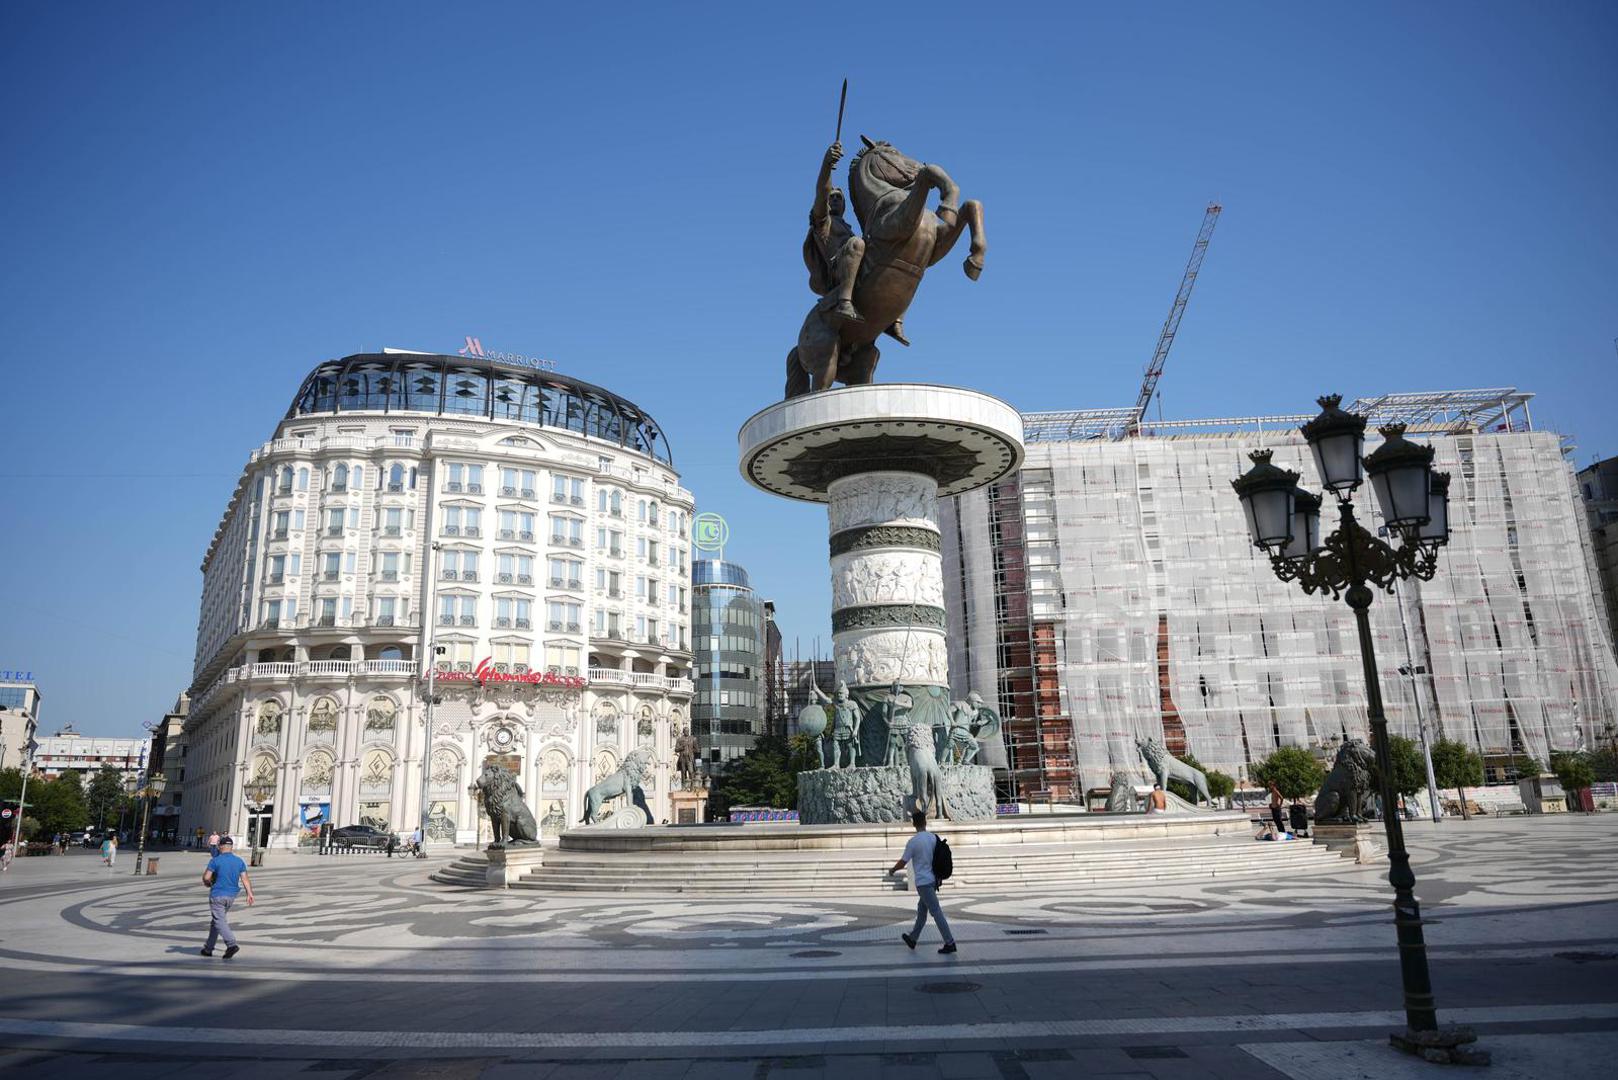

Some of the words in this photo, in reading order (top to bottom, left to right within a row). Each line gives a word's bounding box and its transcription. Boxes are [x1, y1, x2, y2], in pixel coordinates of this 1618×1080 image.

[486, 350, 558, 369] MARRIOTT
[0, 671, 35, 681] TEL
[423, 668, 477, 681] Casino
